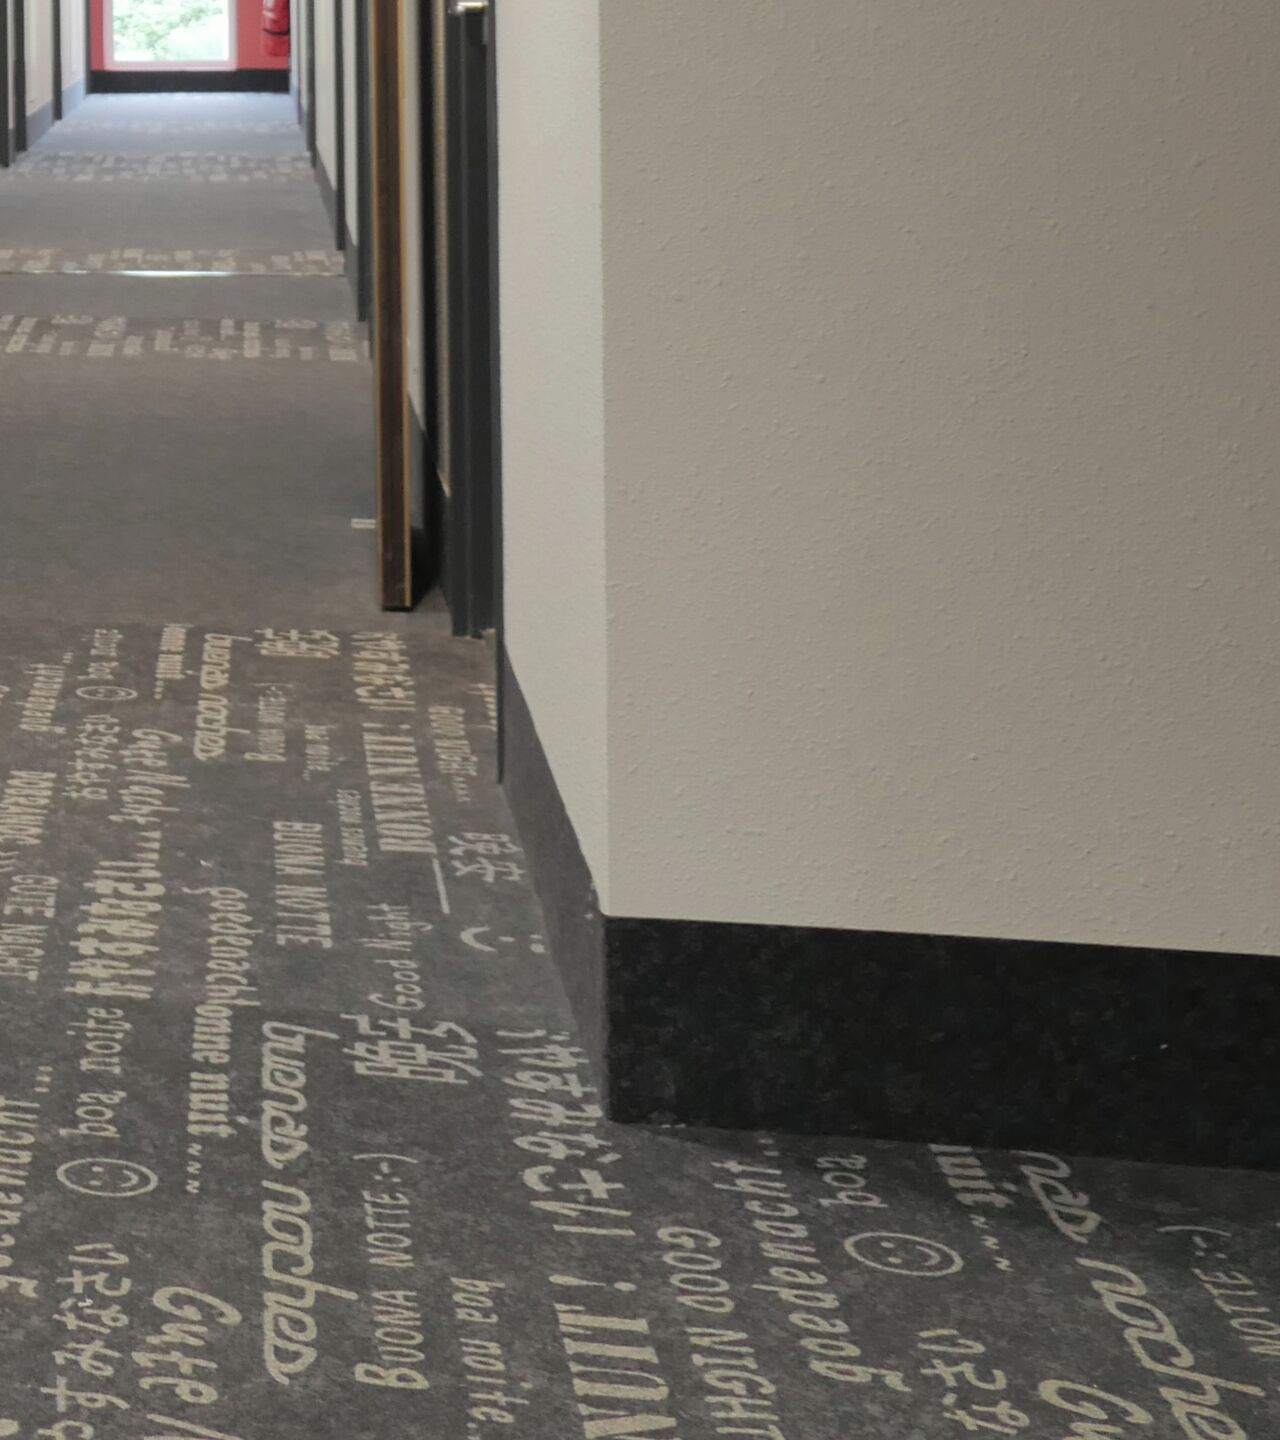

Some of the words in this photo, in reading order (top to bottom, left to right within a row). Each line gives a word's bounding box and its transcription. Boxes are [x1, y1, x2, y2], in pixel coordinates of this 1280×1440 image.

[65, 1006, 132, 1075] noite
[58, 1090, 125, 1138] boa
[260, 1021, 339, 1168] buenas
[360, 1189, 415, 1267] NOTTE
[655, 1224, 734, 1313] GOOD
[260, 1181, 358, 1382] noches
[450, 1276, 506, 1322] boa
[132, 1282, 243, 1405] Gute
[352, 1291, 430, 1388] BUONA
